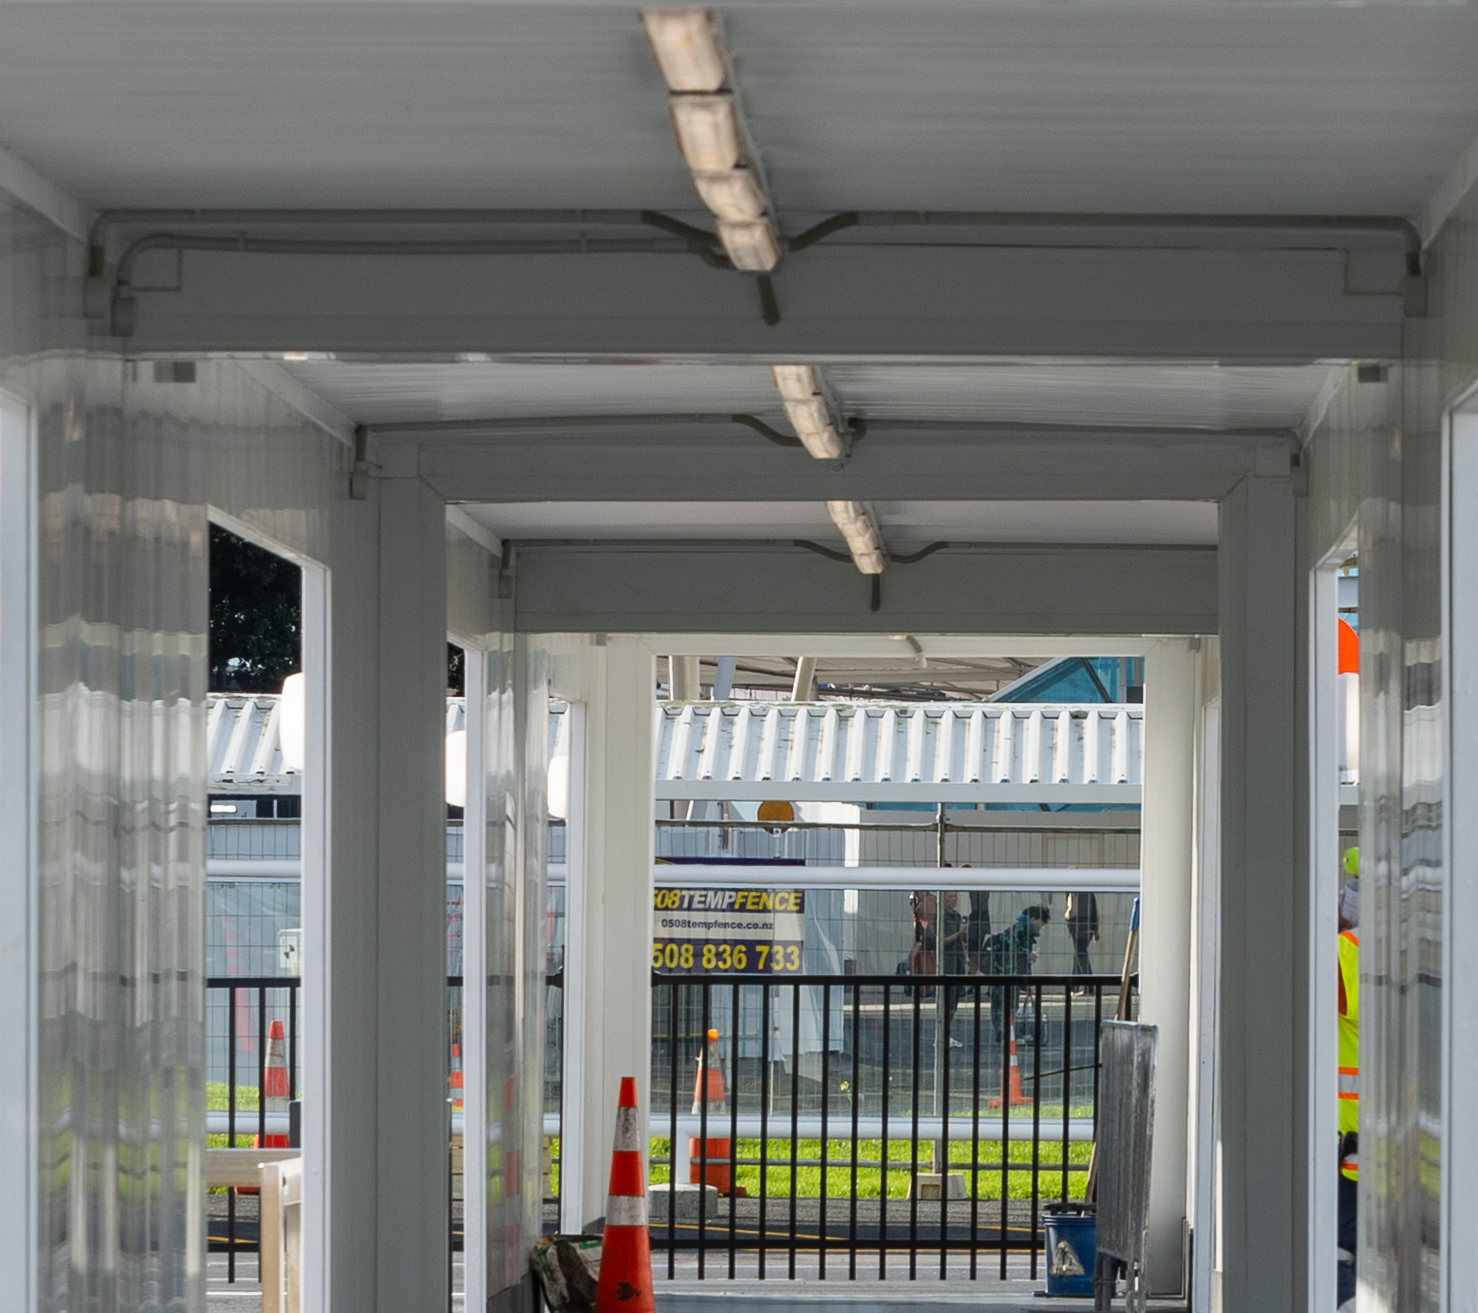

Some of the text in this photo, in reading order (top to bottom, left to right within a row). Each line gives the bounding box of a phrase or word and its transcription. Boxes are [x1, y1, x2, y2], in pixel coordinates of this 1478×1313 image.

[661, 919, 774, 931] 0508tempfence.co.nz
[702, 943, 747, 970] 836
[755, 944, 800, 971] 733
